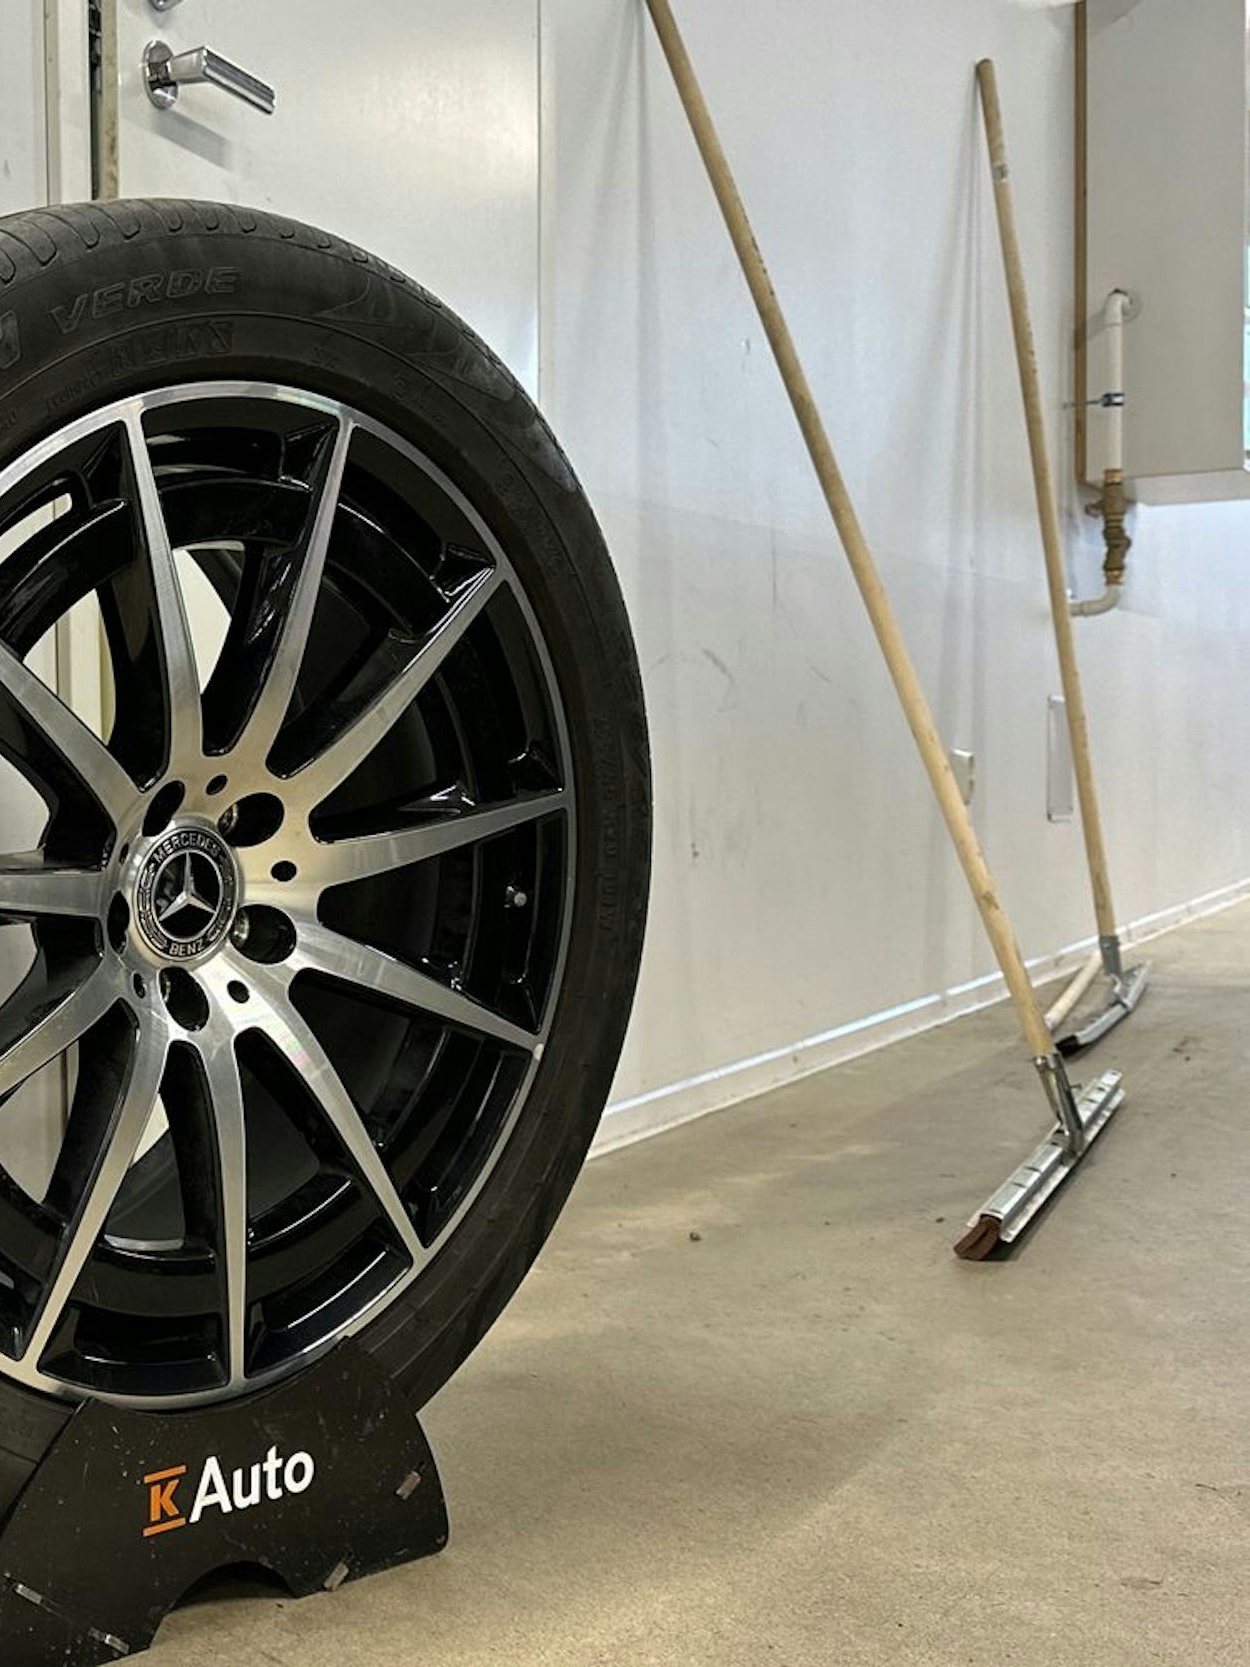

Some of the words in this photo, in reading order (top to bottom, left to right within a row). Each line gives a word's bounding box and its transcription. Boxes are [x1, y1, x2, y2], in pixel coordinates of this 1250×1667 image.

[50, 266, 244, 335] VERDE
[168, 939, 205, 957] BENZ
[188, 1444, 315, 1524] Auto
